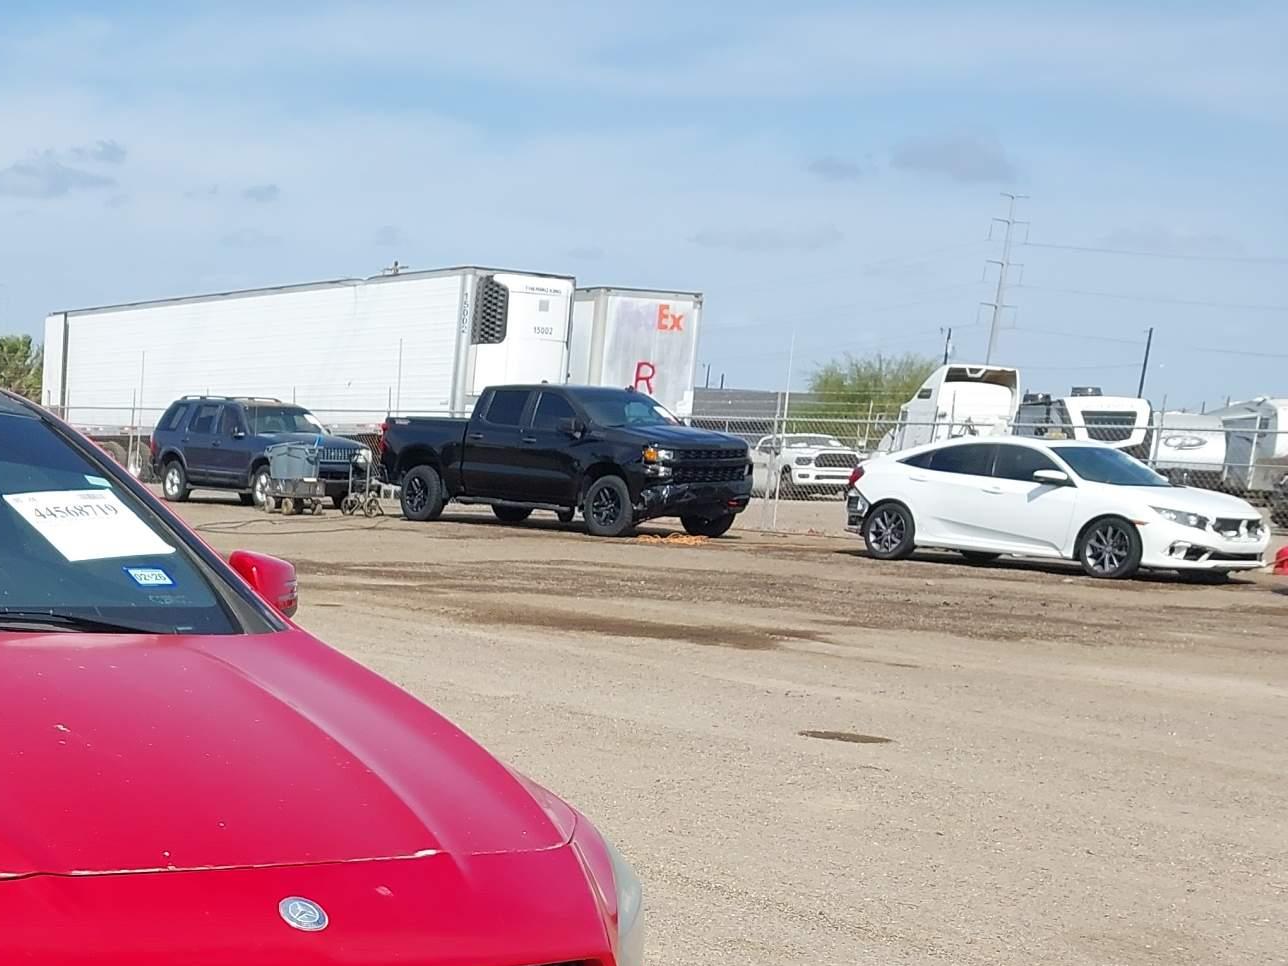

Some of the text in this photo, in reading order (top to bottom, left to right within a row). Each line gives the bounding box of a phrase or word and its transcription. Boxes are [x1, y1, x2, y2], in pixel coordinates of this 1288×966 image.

[657, 304, 684, 331] Ex
[533, 326, 554, 335] 15002
[634, 361, 656, 395] R
[33, 503, 119, 520] 44568719
